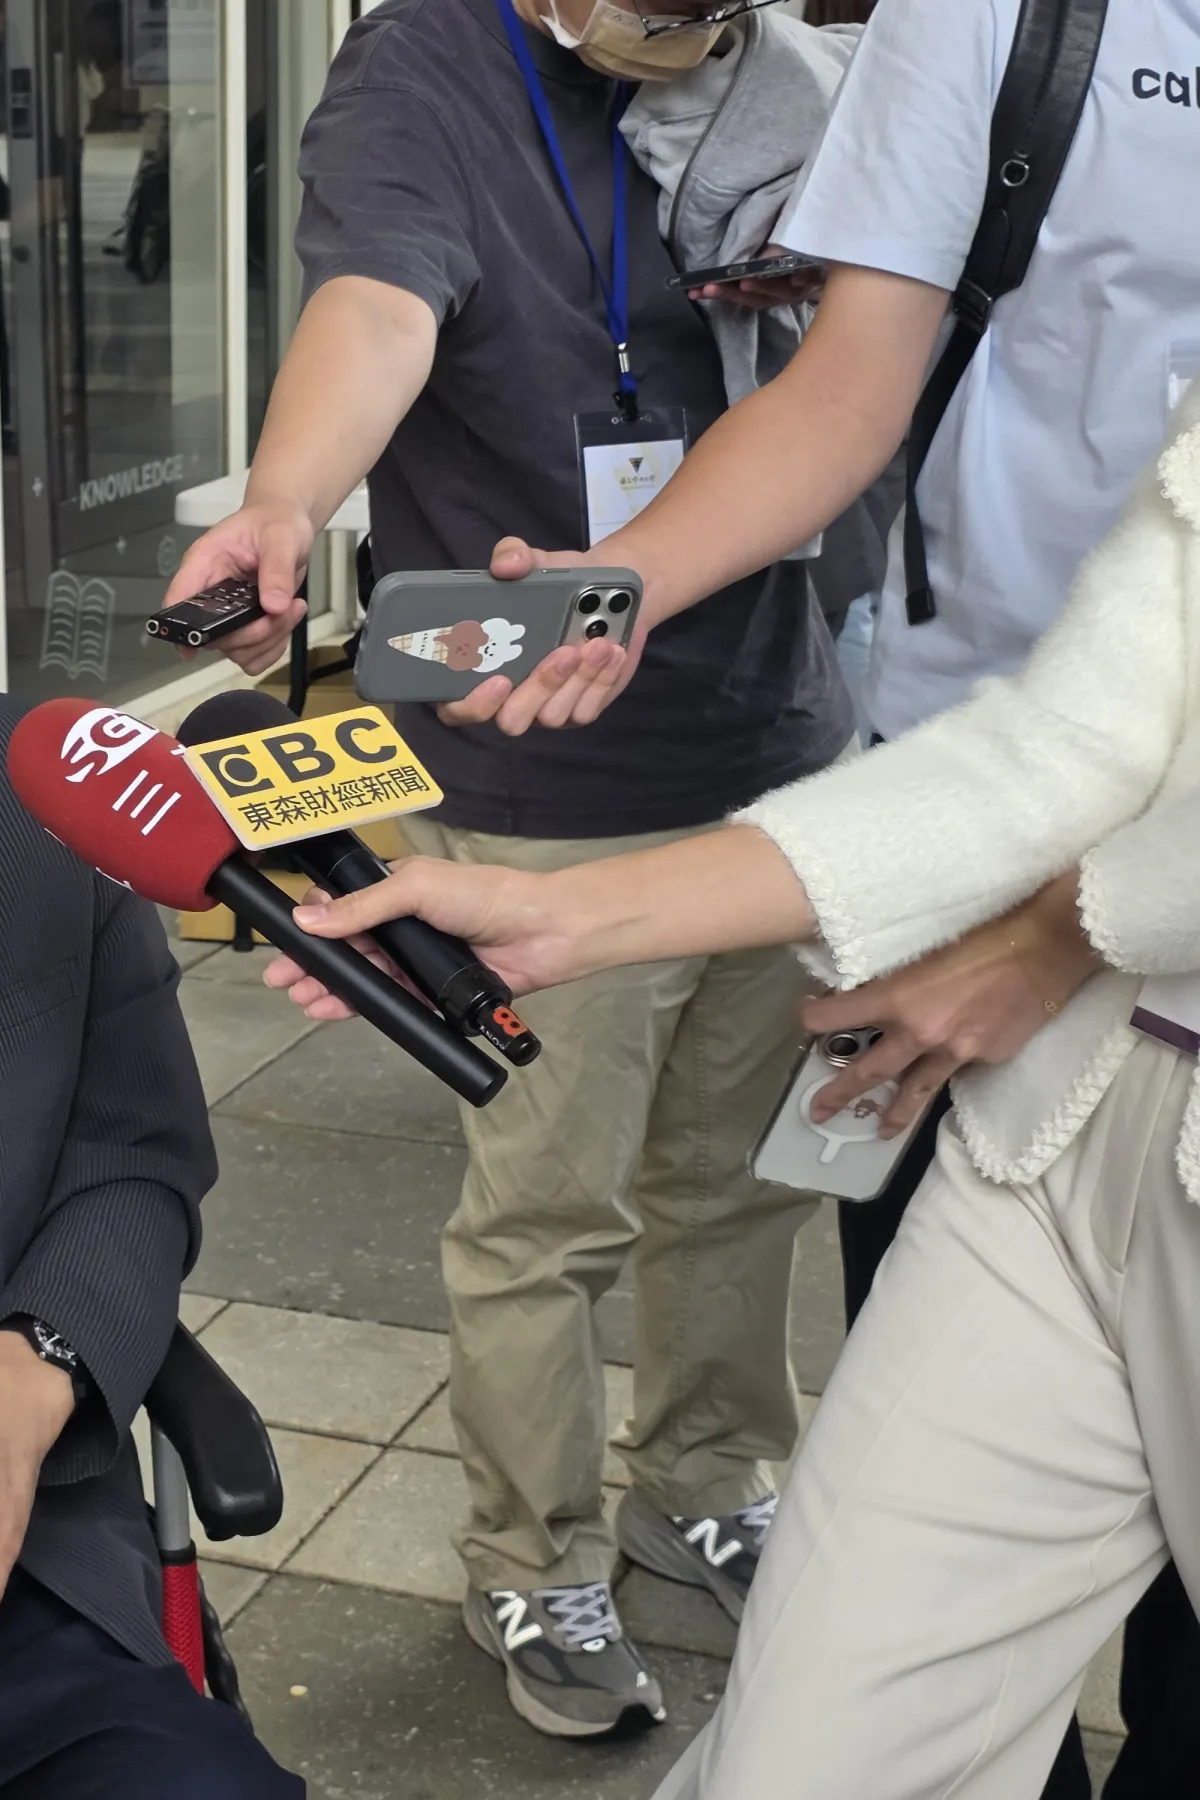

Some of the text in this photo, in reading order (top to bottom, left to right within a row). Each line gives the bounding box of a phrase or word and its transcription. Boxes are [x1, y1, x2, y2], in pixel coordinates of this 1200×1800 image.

[79, 453, 185, 511] KNOWLEDGE
[238, 765, 430, 832] 東森財經新聞
